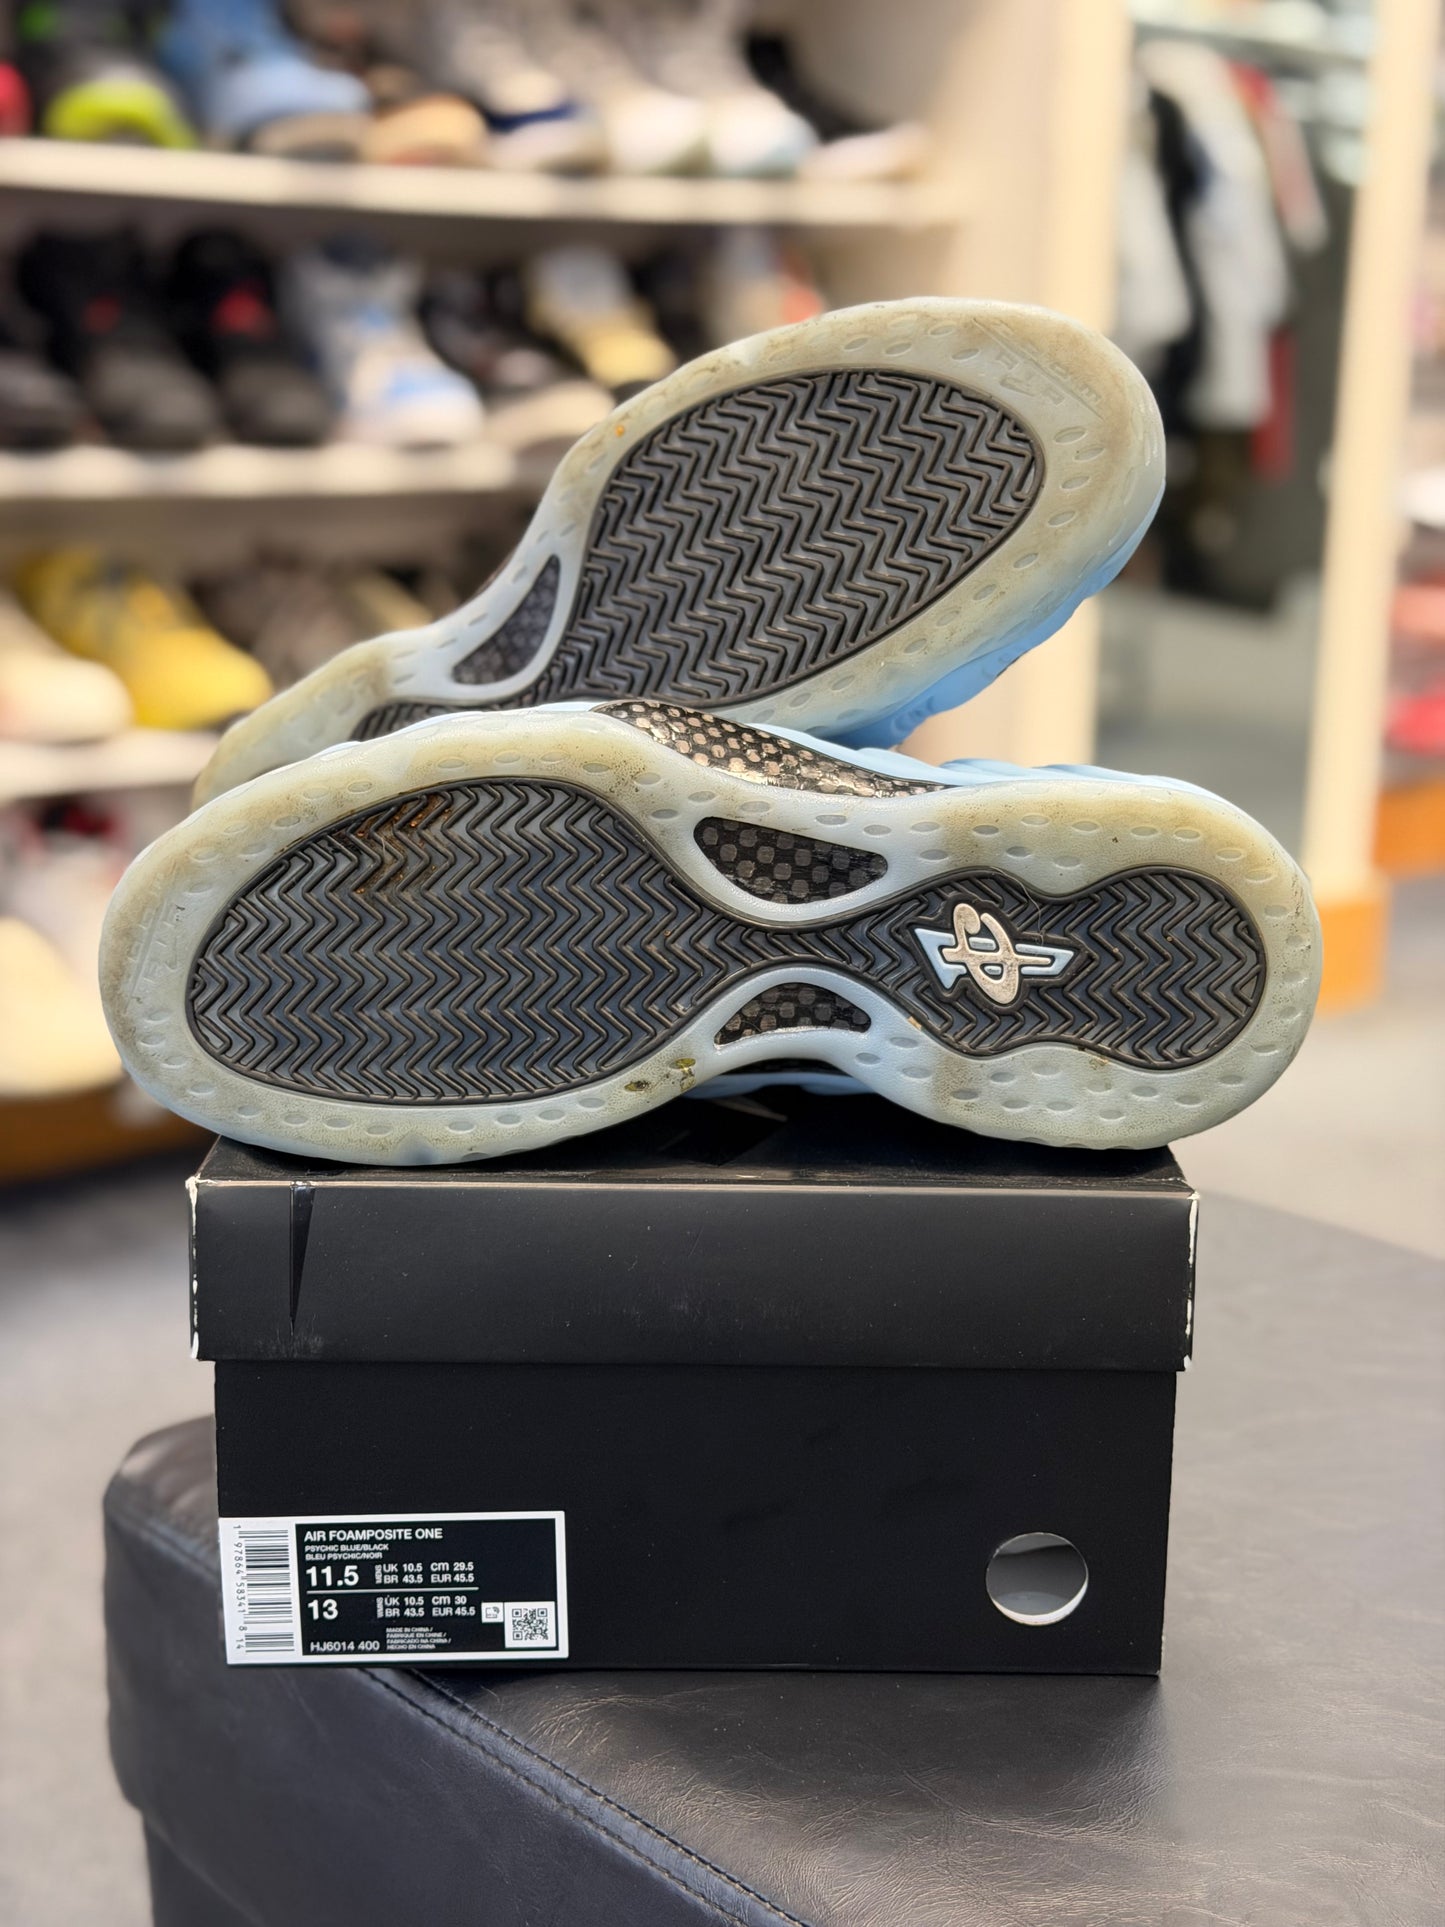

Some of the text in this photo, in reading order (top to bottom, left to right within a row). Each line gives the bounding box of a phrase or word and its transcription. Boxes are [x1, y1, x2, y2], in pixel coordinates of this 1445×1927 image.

[304, 1528, 443, 1542] AIR FOAMPOSITE ONE
[340, 1543, 389, 1551] BLUE/BLACK
[234, 1542, 244, 1575] 97864
[327, 1552, 383, 1560] PSYCHIC/NOIR
[383, 1563, 399, 1573] UK
[402, 1562, 423, 1572] 10.5
[453, 1561, 475, 1571] 29.5
[305, 1565, 360, 1587] 11.5
[383, 1573, 475, 1584] BR 43.5 EUR 45.5
[236, 1582, 246, 1613] 58341
[384, 1596, 400, 1606] UK
[404, 1596, 425, 1606] 10.5
[454, 1595, 468, 1605] 30
[307, 1598, 339, 1620] 13
[384, 1606, 476, 1617] BR 43.5 EUR 45.5
[310, 1641, 380, 1652] HJ6014 400
